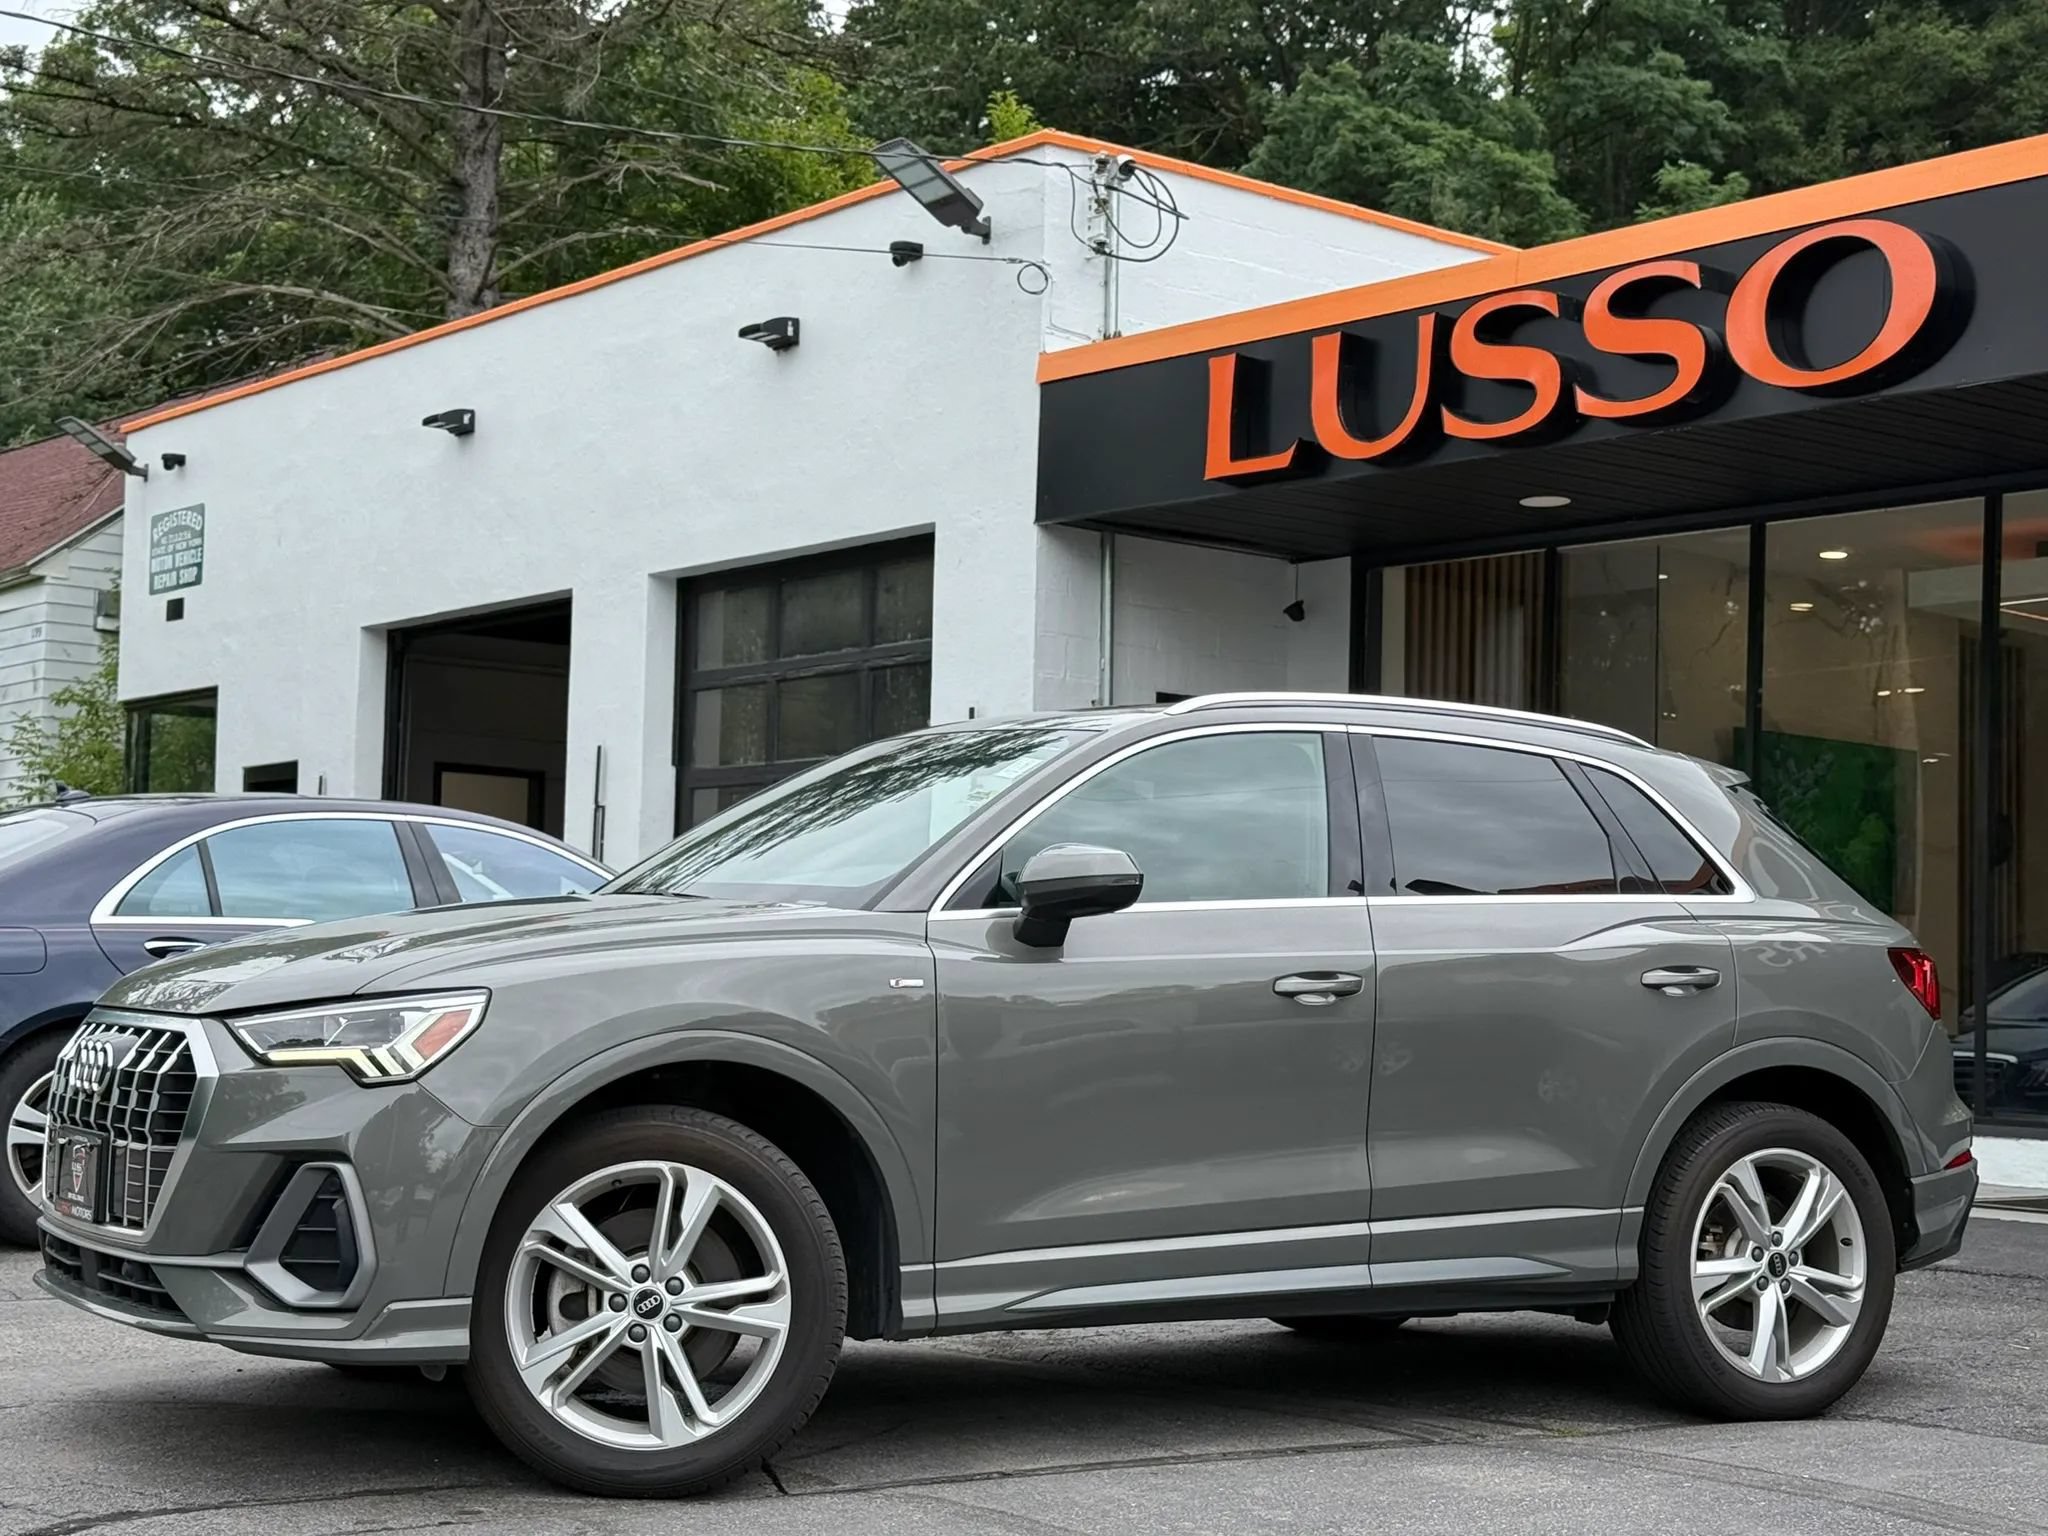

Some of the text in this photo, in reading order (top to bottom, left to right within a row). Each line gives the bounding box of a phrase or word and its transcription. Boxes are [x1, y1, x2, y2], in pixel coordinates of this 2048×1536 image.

[1204, 218, 1937, 481] LUSSO
[153, 510, 203, 544] REGISTERED
[175, 548, 203, 567] VEHICLE
[153, 566, 198, 591] REPAIR SHOP
[72, 1207, 92, 1220] MOTORS
